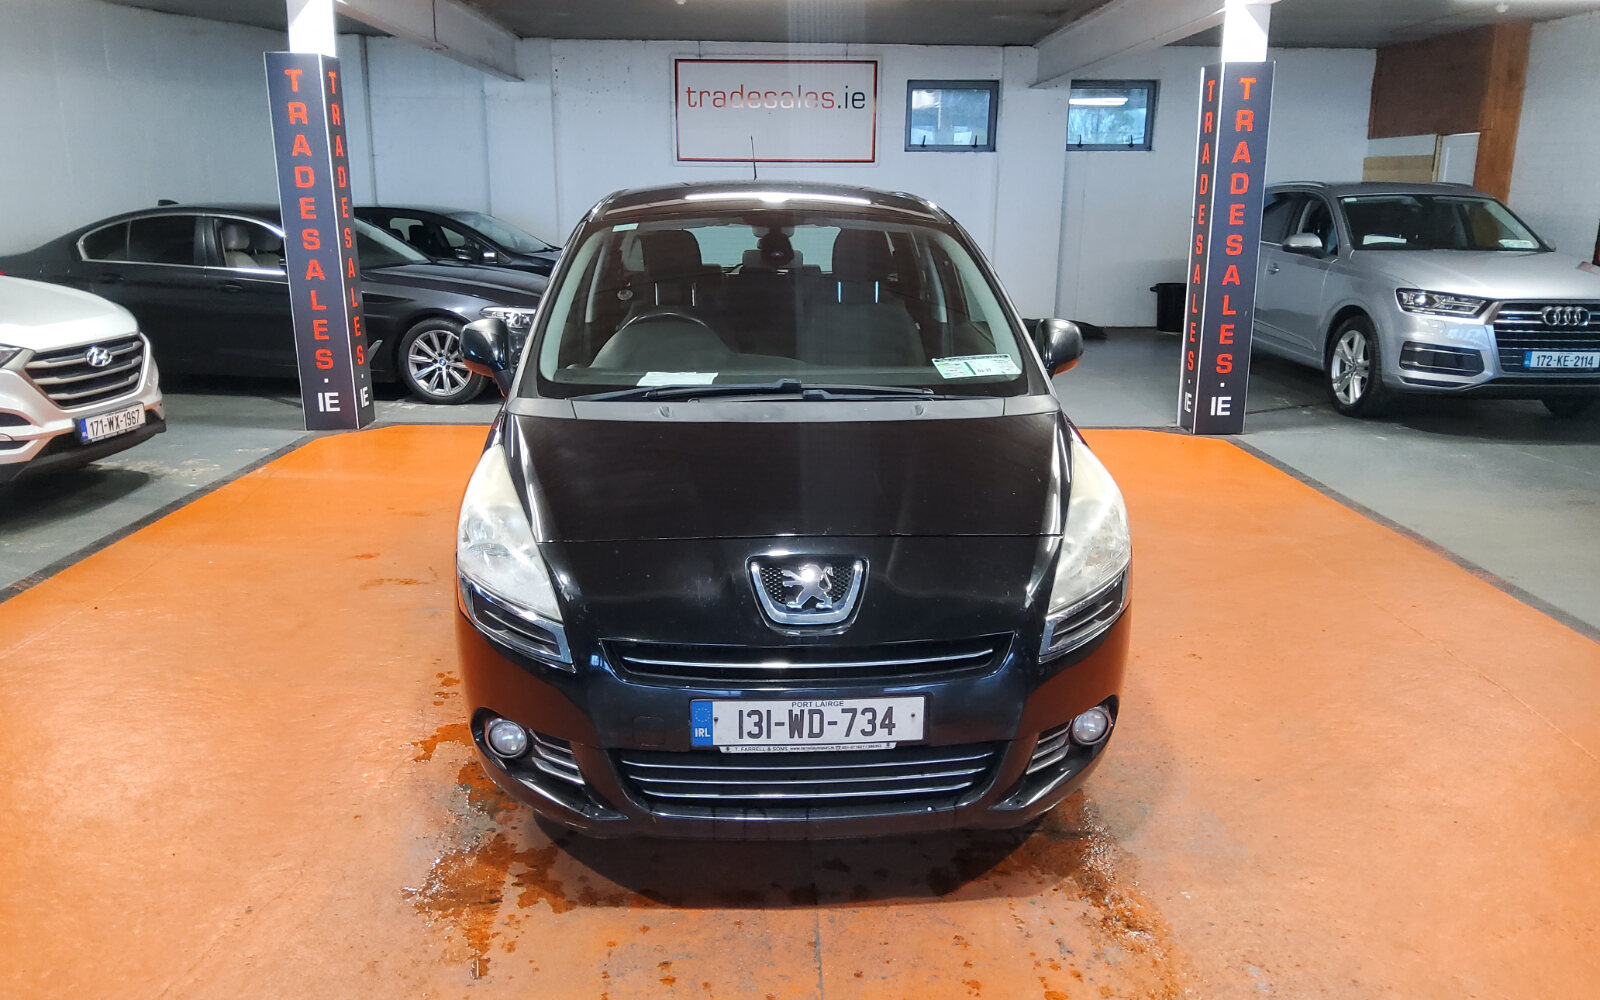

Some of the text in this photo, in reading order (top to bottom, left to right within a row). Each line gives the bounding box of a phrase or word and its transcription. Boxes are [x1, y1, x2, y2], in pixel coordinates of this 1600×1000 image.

[685, 84, 866, 110] tradesales.ie
[1536, 354, 1594, 367] 172-KE-2114
[89, 409, 140, 437] 171-WX-1967
[694, 727, 711, 738] IRL
[738, 706, 896, 740] 131-WD-734
